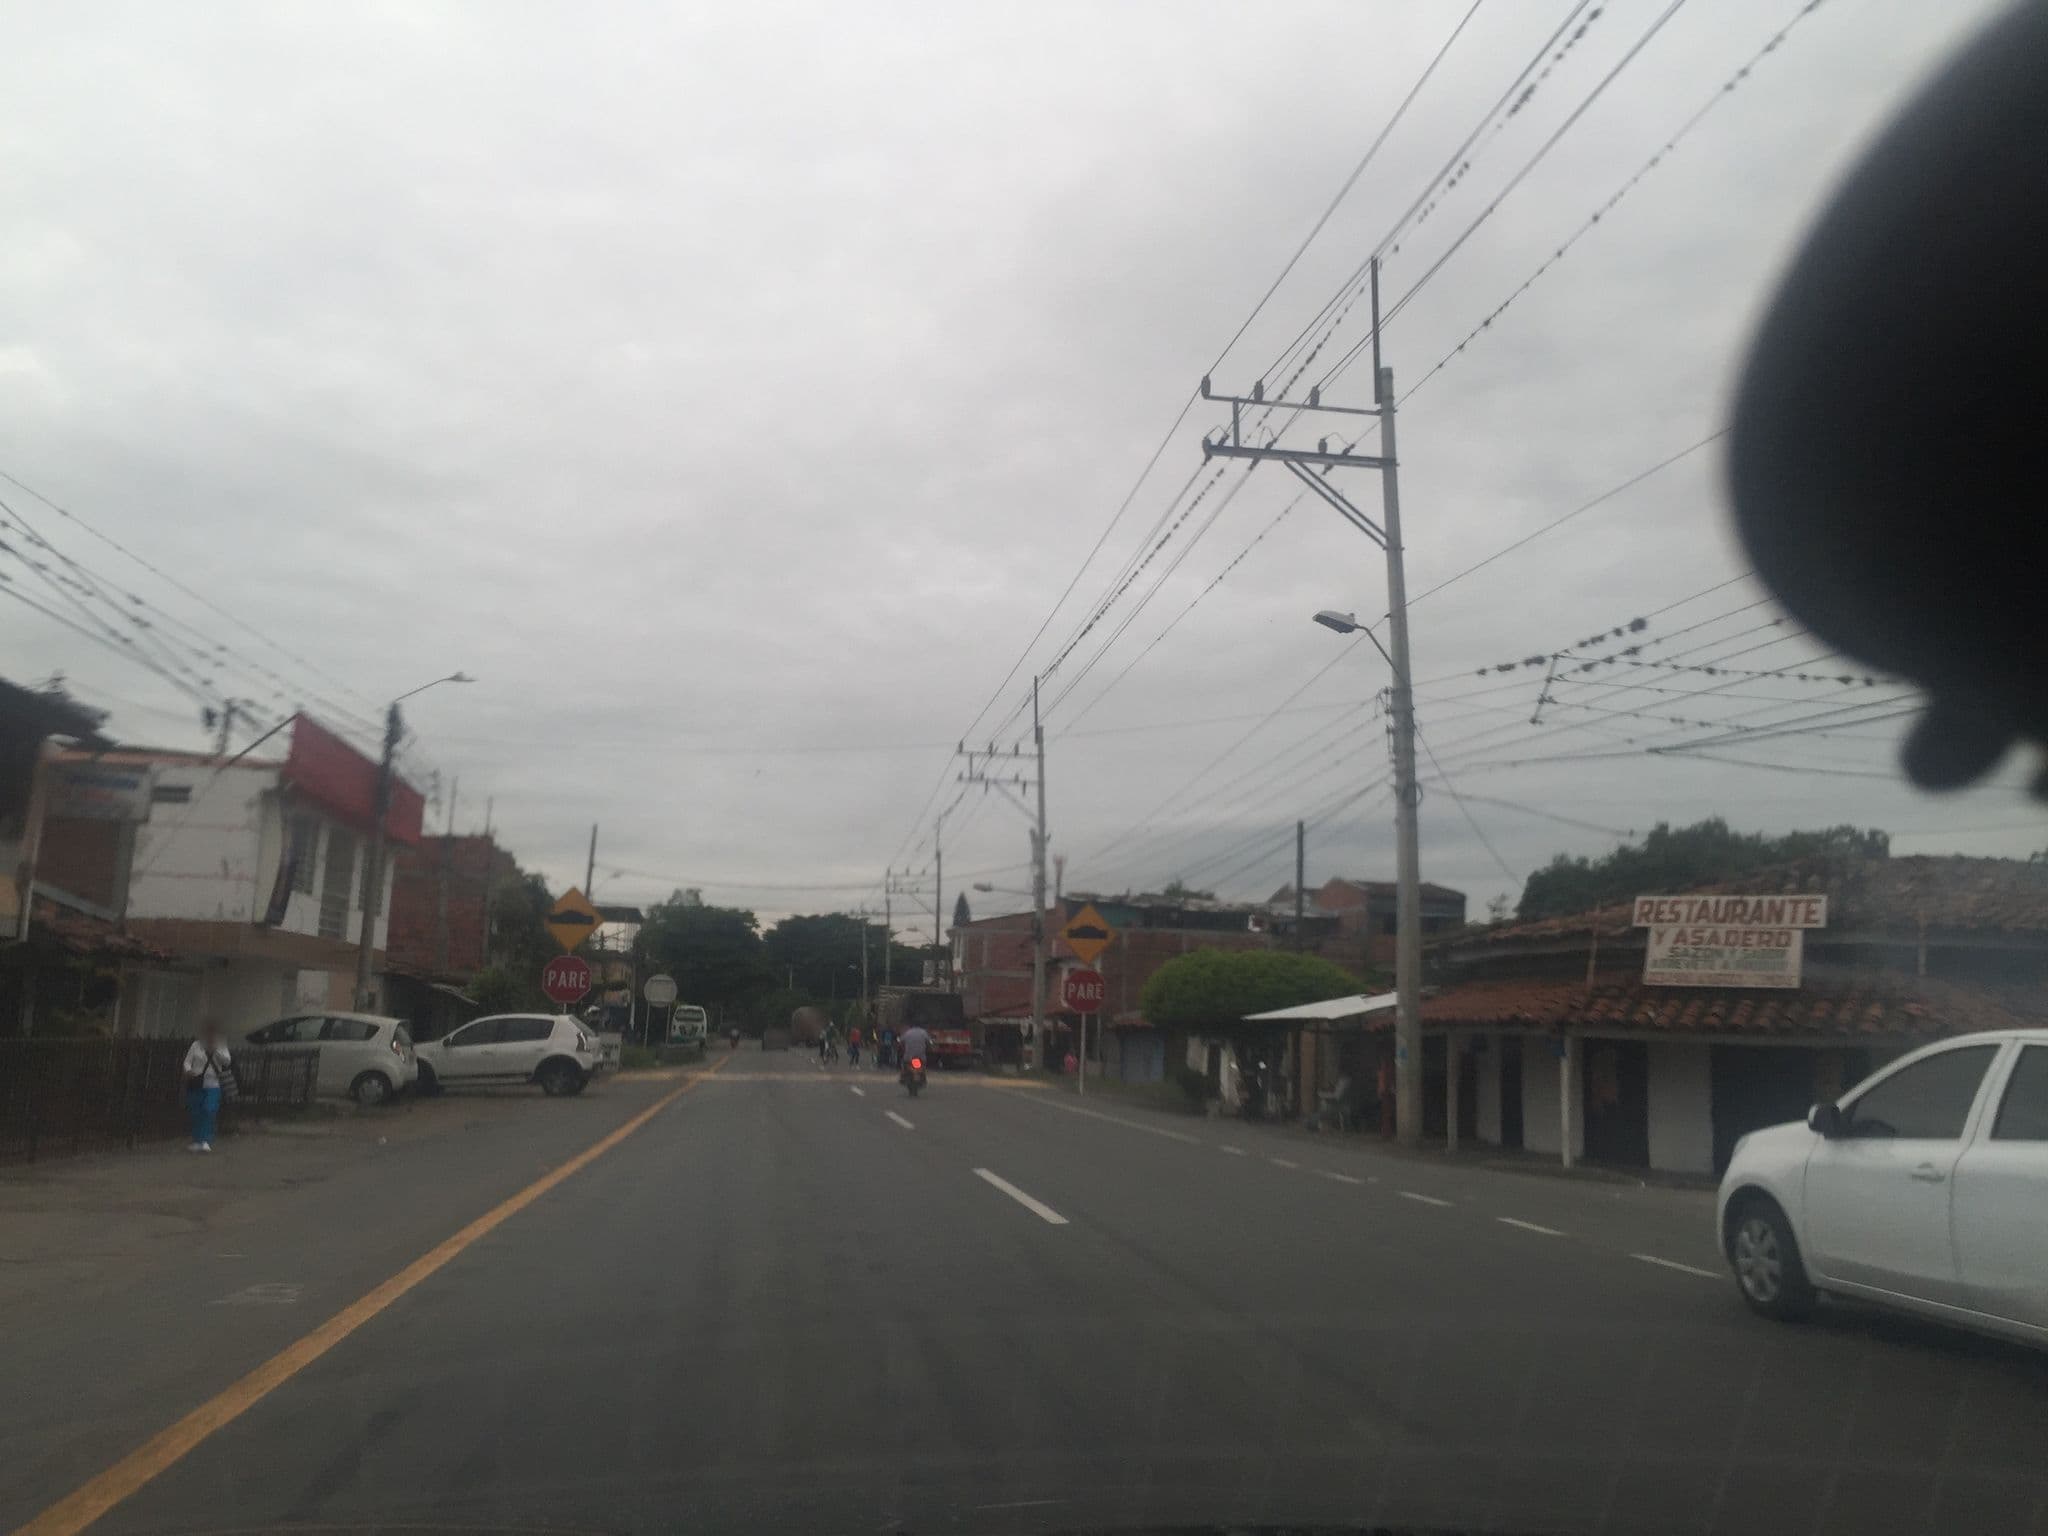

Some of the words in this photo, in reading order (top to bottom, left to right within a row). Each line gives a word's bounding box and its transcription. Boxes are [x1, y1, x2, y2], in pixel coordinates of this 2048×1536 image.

[1637, 898, 1821, 924] RESTAURANTE
[1655, 929, 1667, 944] Y
[1673, 930, 1792, 946] ASADERO
[548, 970, 587, 988] PARE
[1068, 983, 1103, 1000] PARE
